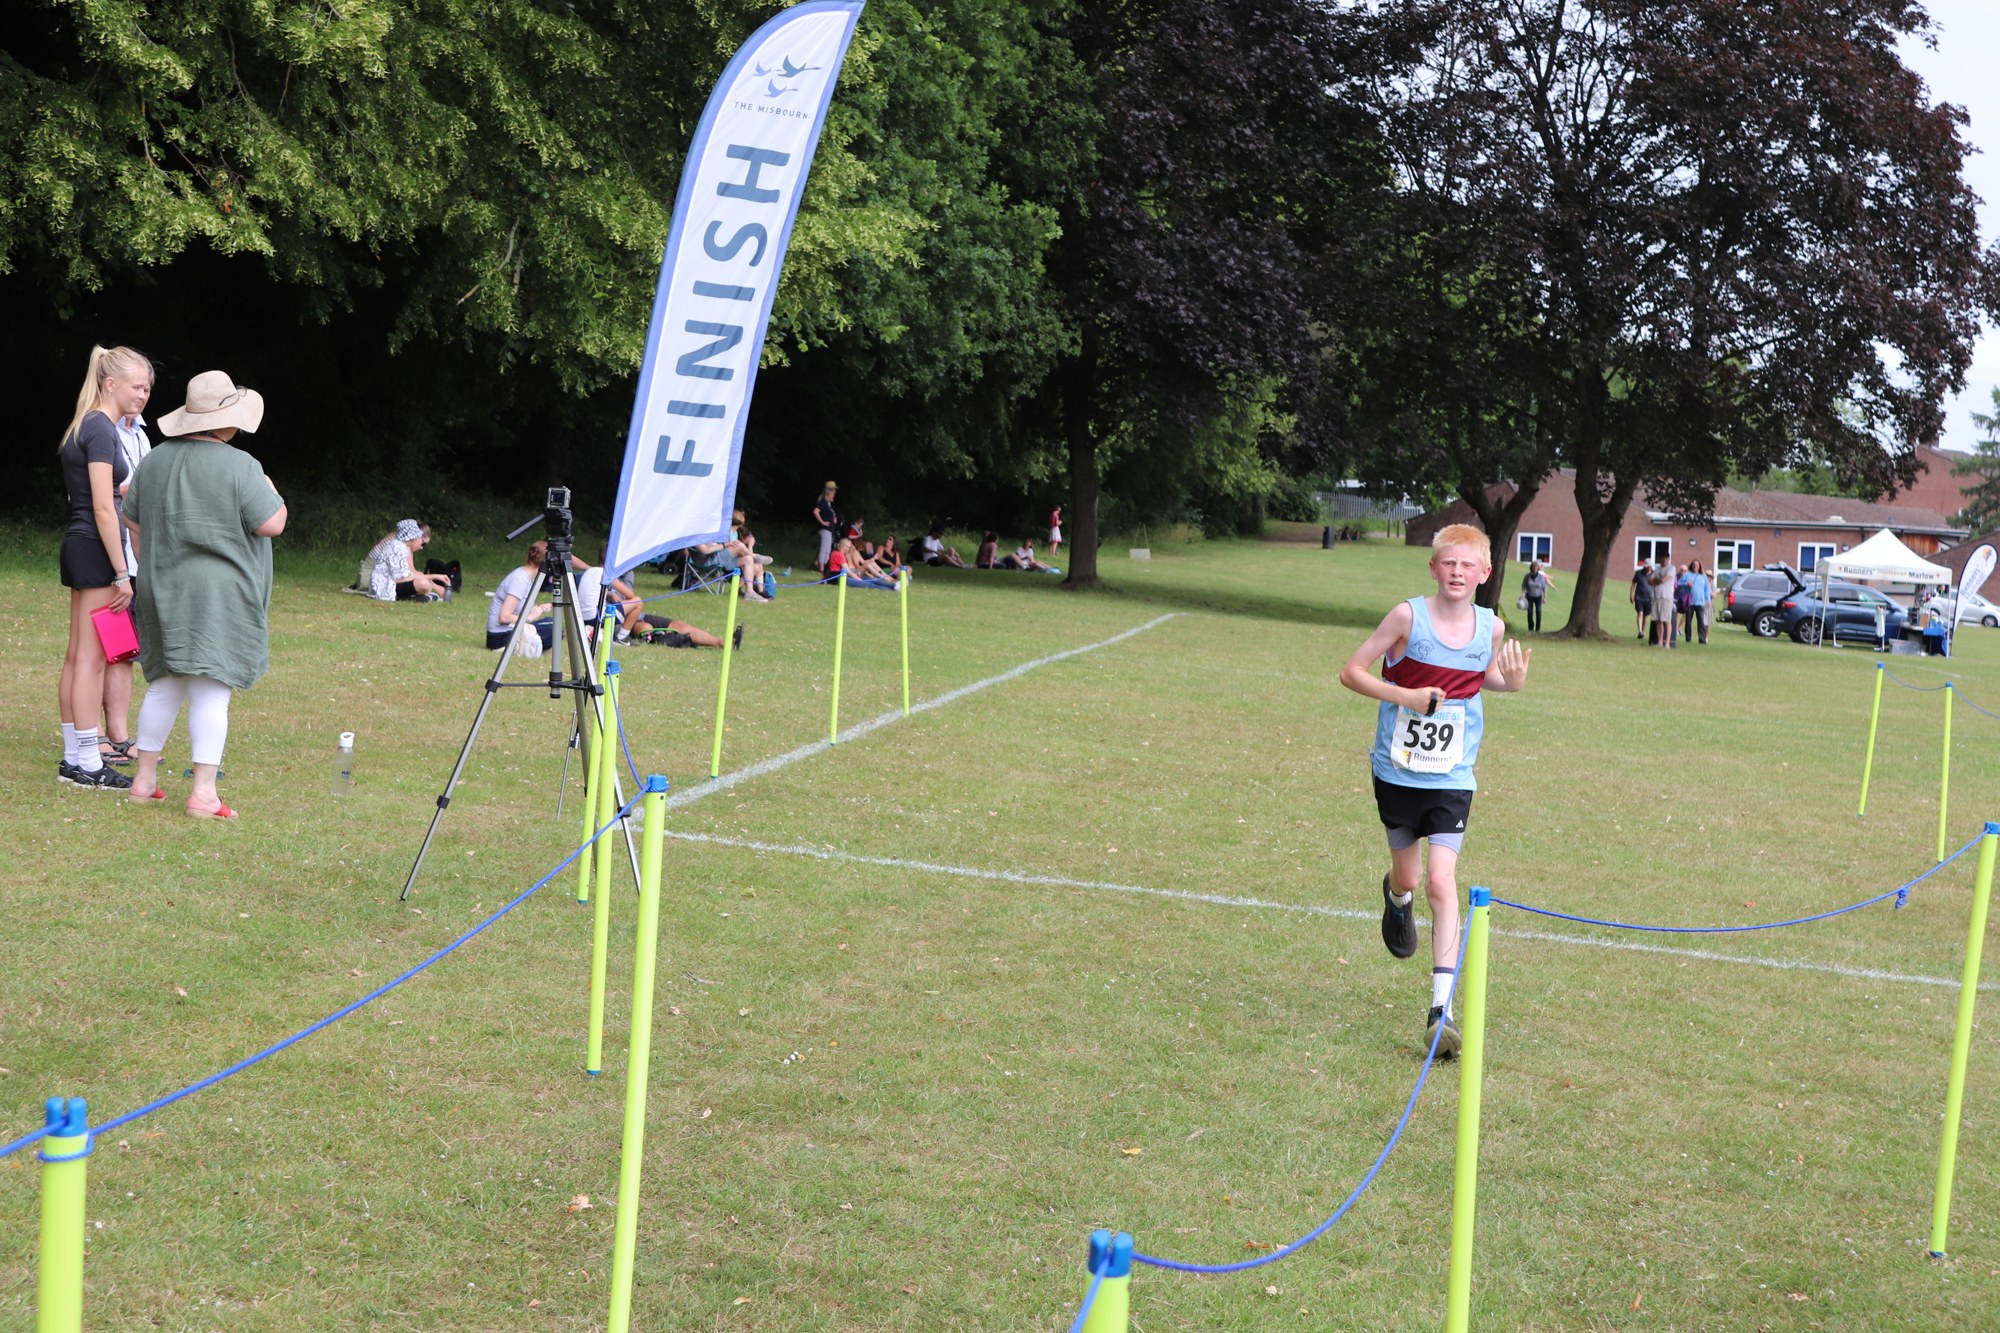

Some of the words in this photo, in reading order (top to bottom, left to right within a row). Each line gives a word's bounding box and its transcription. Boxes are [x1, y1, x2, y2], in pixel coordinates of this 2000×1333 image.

[734, 101, 753, 111] THE
[653, 143, 791, 478] FINISH
[1908, 571, 1934, 580] Marlow
[1403, 719, 1454, 752] 539
